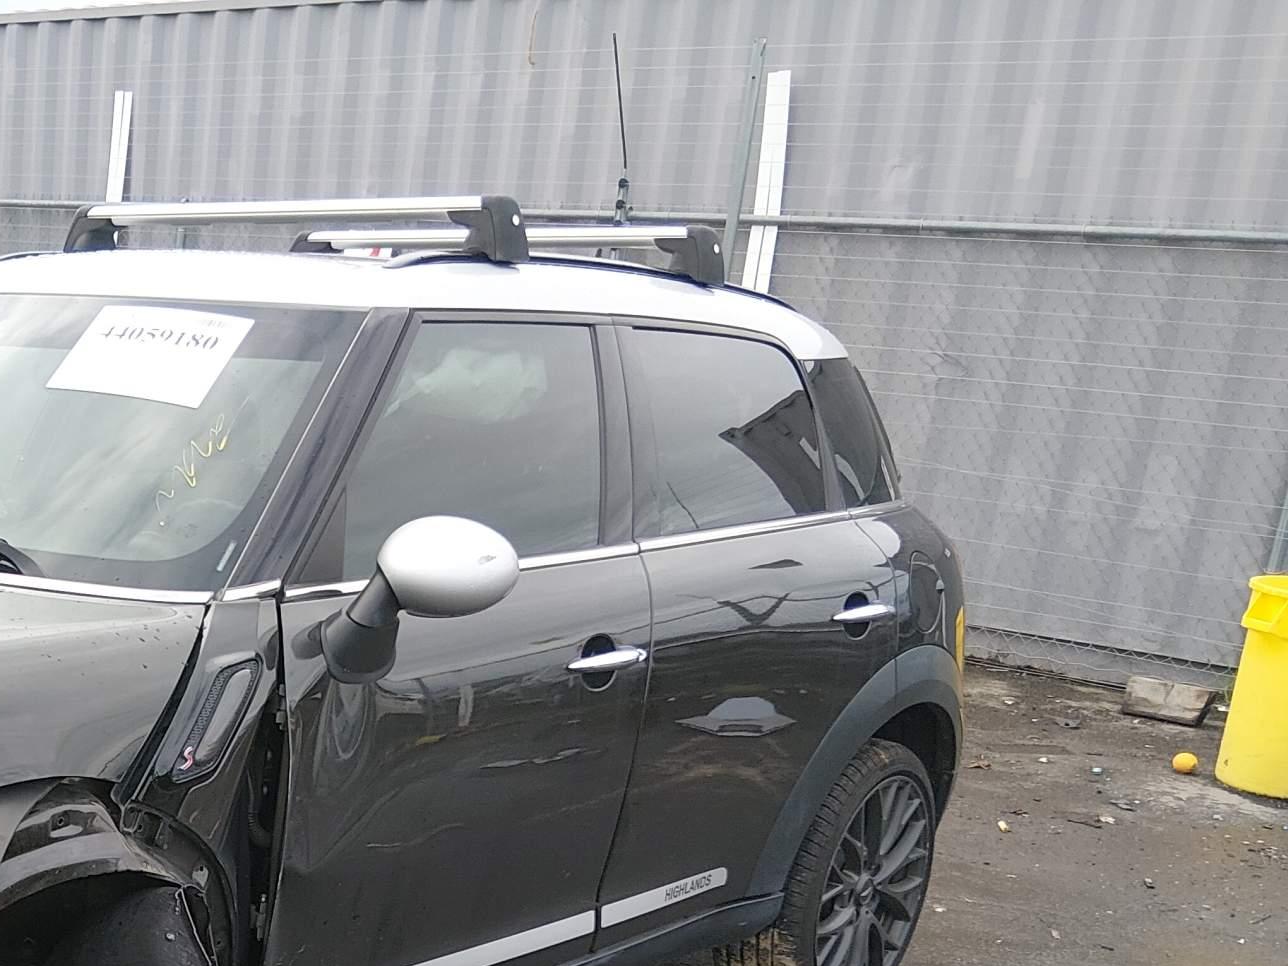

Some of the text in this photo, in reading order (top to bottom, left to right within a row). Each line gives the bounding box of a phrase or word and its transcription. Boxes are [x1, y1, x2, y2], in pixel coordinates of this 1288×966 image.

[100, 325, 220, 350] 44059180
[177, 746, 194, 770] S
[664, 873, 713, 902] HIGHLANDS
